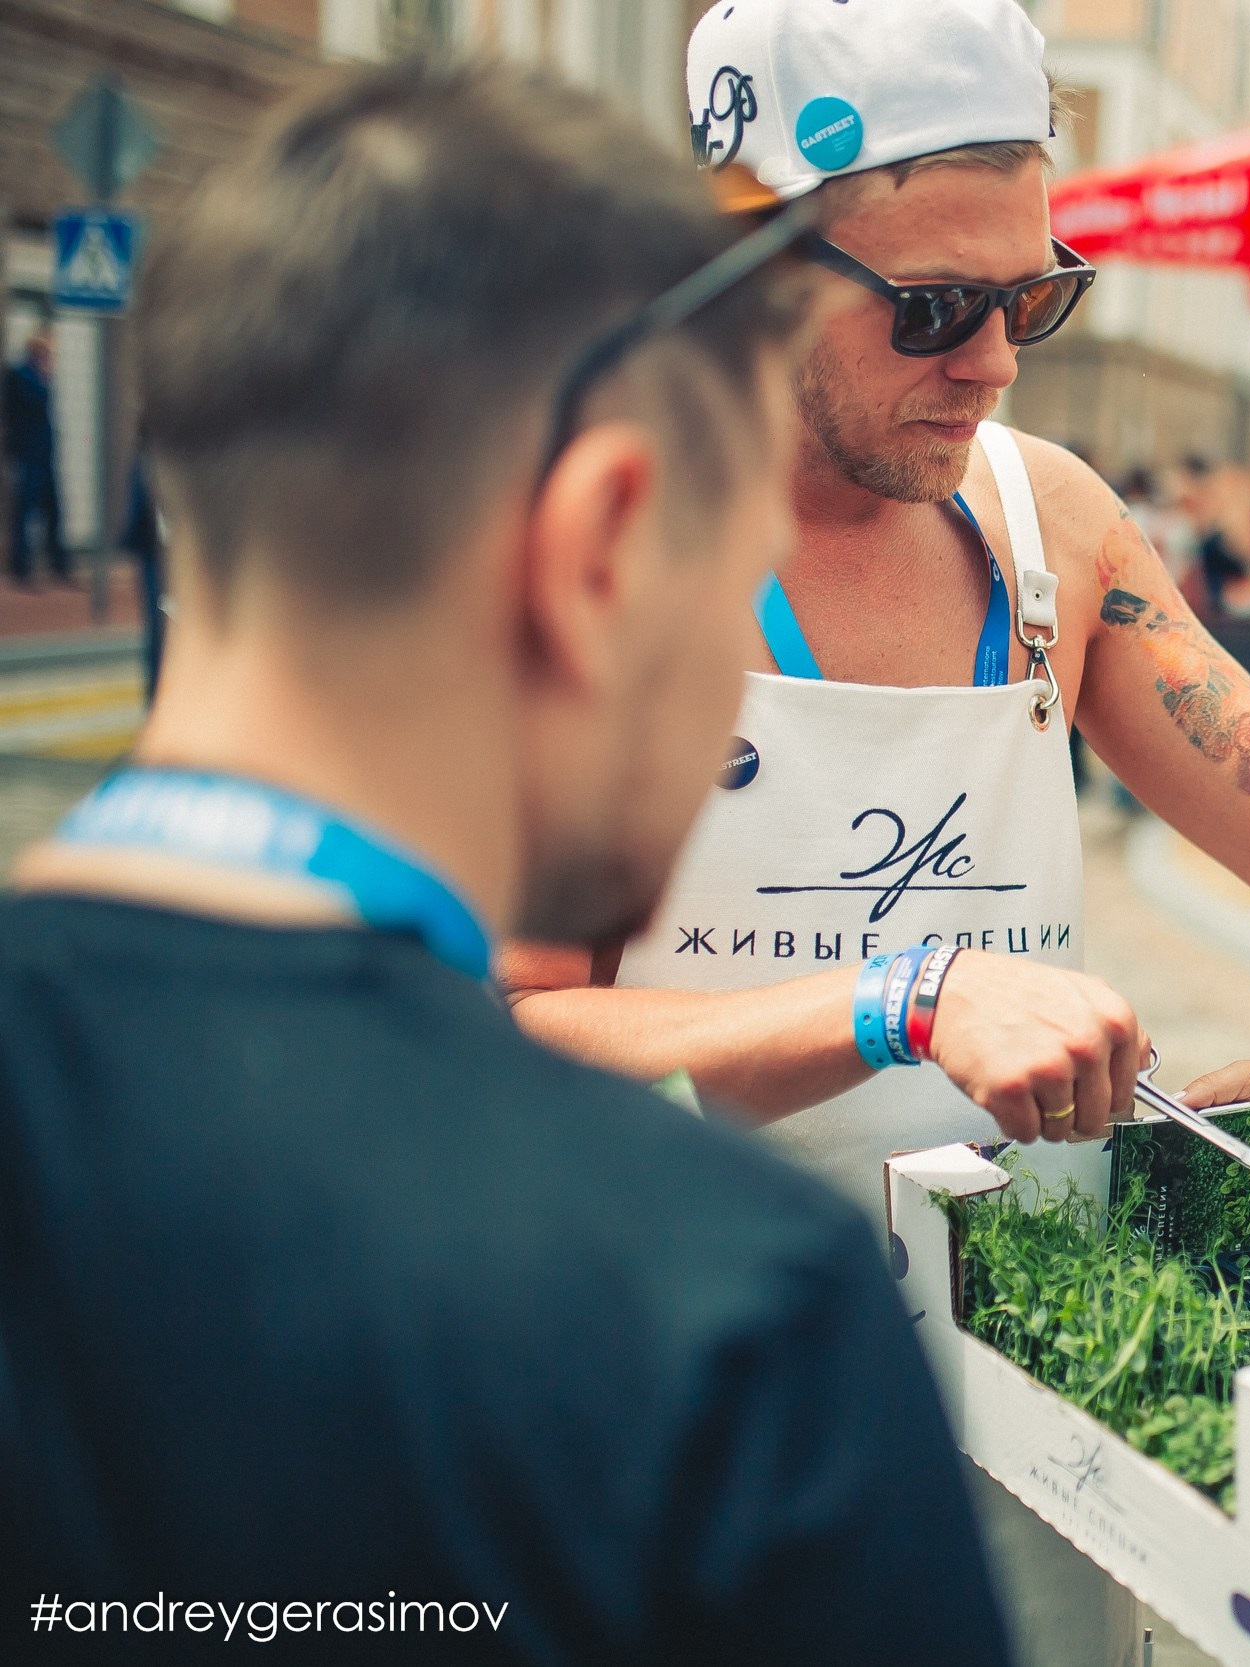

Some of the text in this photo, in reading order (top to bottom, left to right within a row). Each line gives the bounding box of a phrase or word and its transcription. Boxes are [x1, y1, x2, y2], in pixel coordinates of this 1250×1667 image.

[801, 114, 855, 149] GASTREET
[982, 645, 991, 686] nternational
[719, 751, 757, 771] STREET
[674, 926, 879, 961] ЖИВЫЕ
